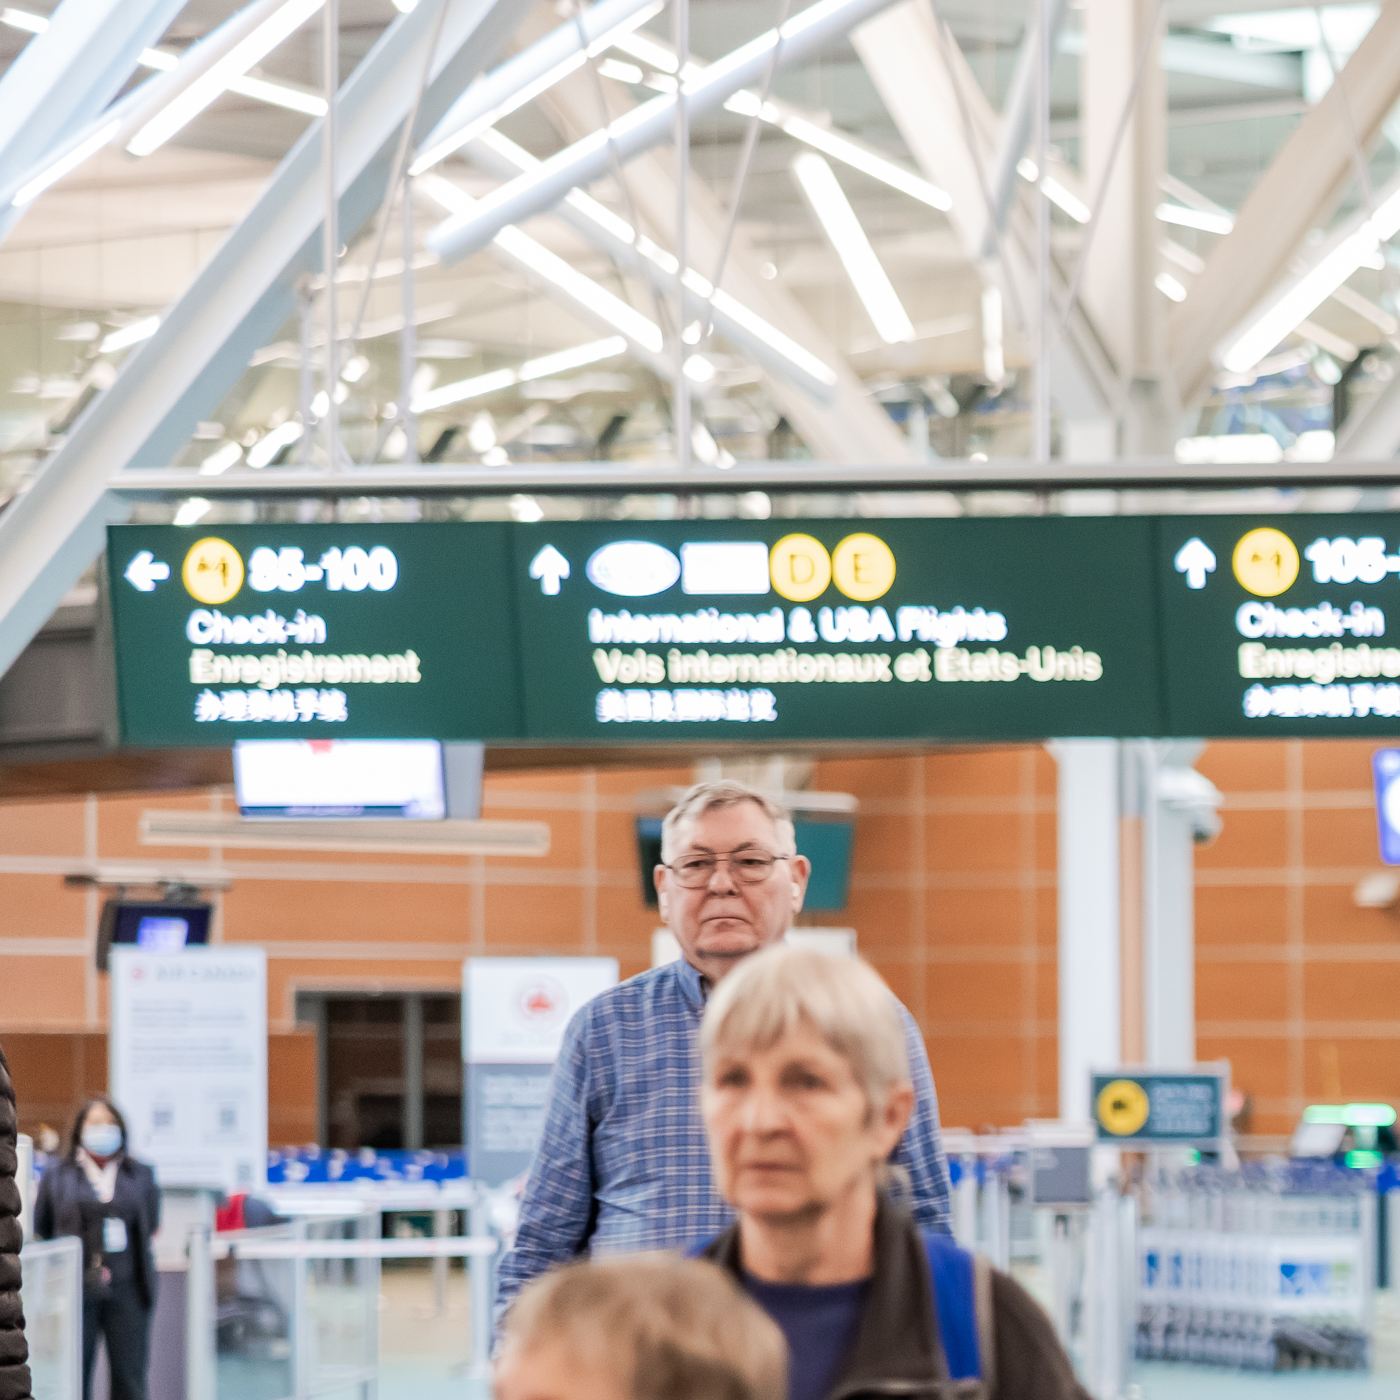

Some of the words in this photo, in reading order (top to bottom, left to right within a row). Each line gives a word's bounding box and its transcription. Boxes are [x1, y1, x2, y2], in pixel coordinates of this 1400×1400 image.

[789, 554, 815, 584] D
[854, 553, 875, 584] E
[186, 608, 327, 644] Check-in
[588, 607, 785, 643] International
[787, 607, 818, 643] &
[818, 606, 896, 642] USA
[897, 606, 1008, 649] Flights
[1236, 601, 1385, 638] Check-in
[189, 649, 421, 691] Enregistrement
[593, 648, 665, 683] Vols
[668, 648, 892, 683] internationaux
[894, 648, 932, 683] et
